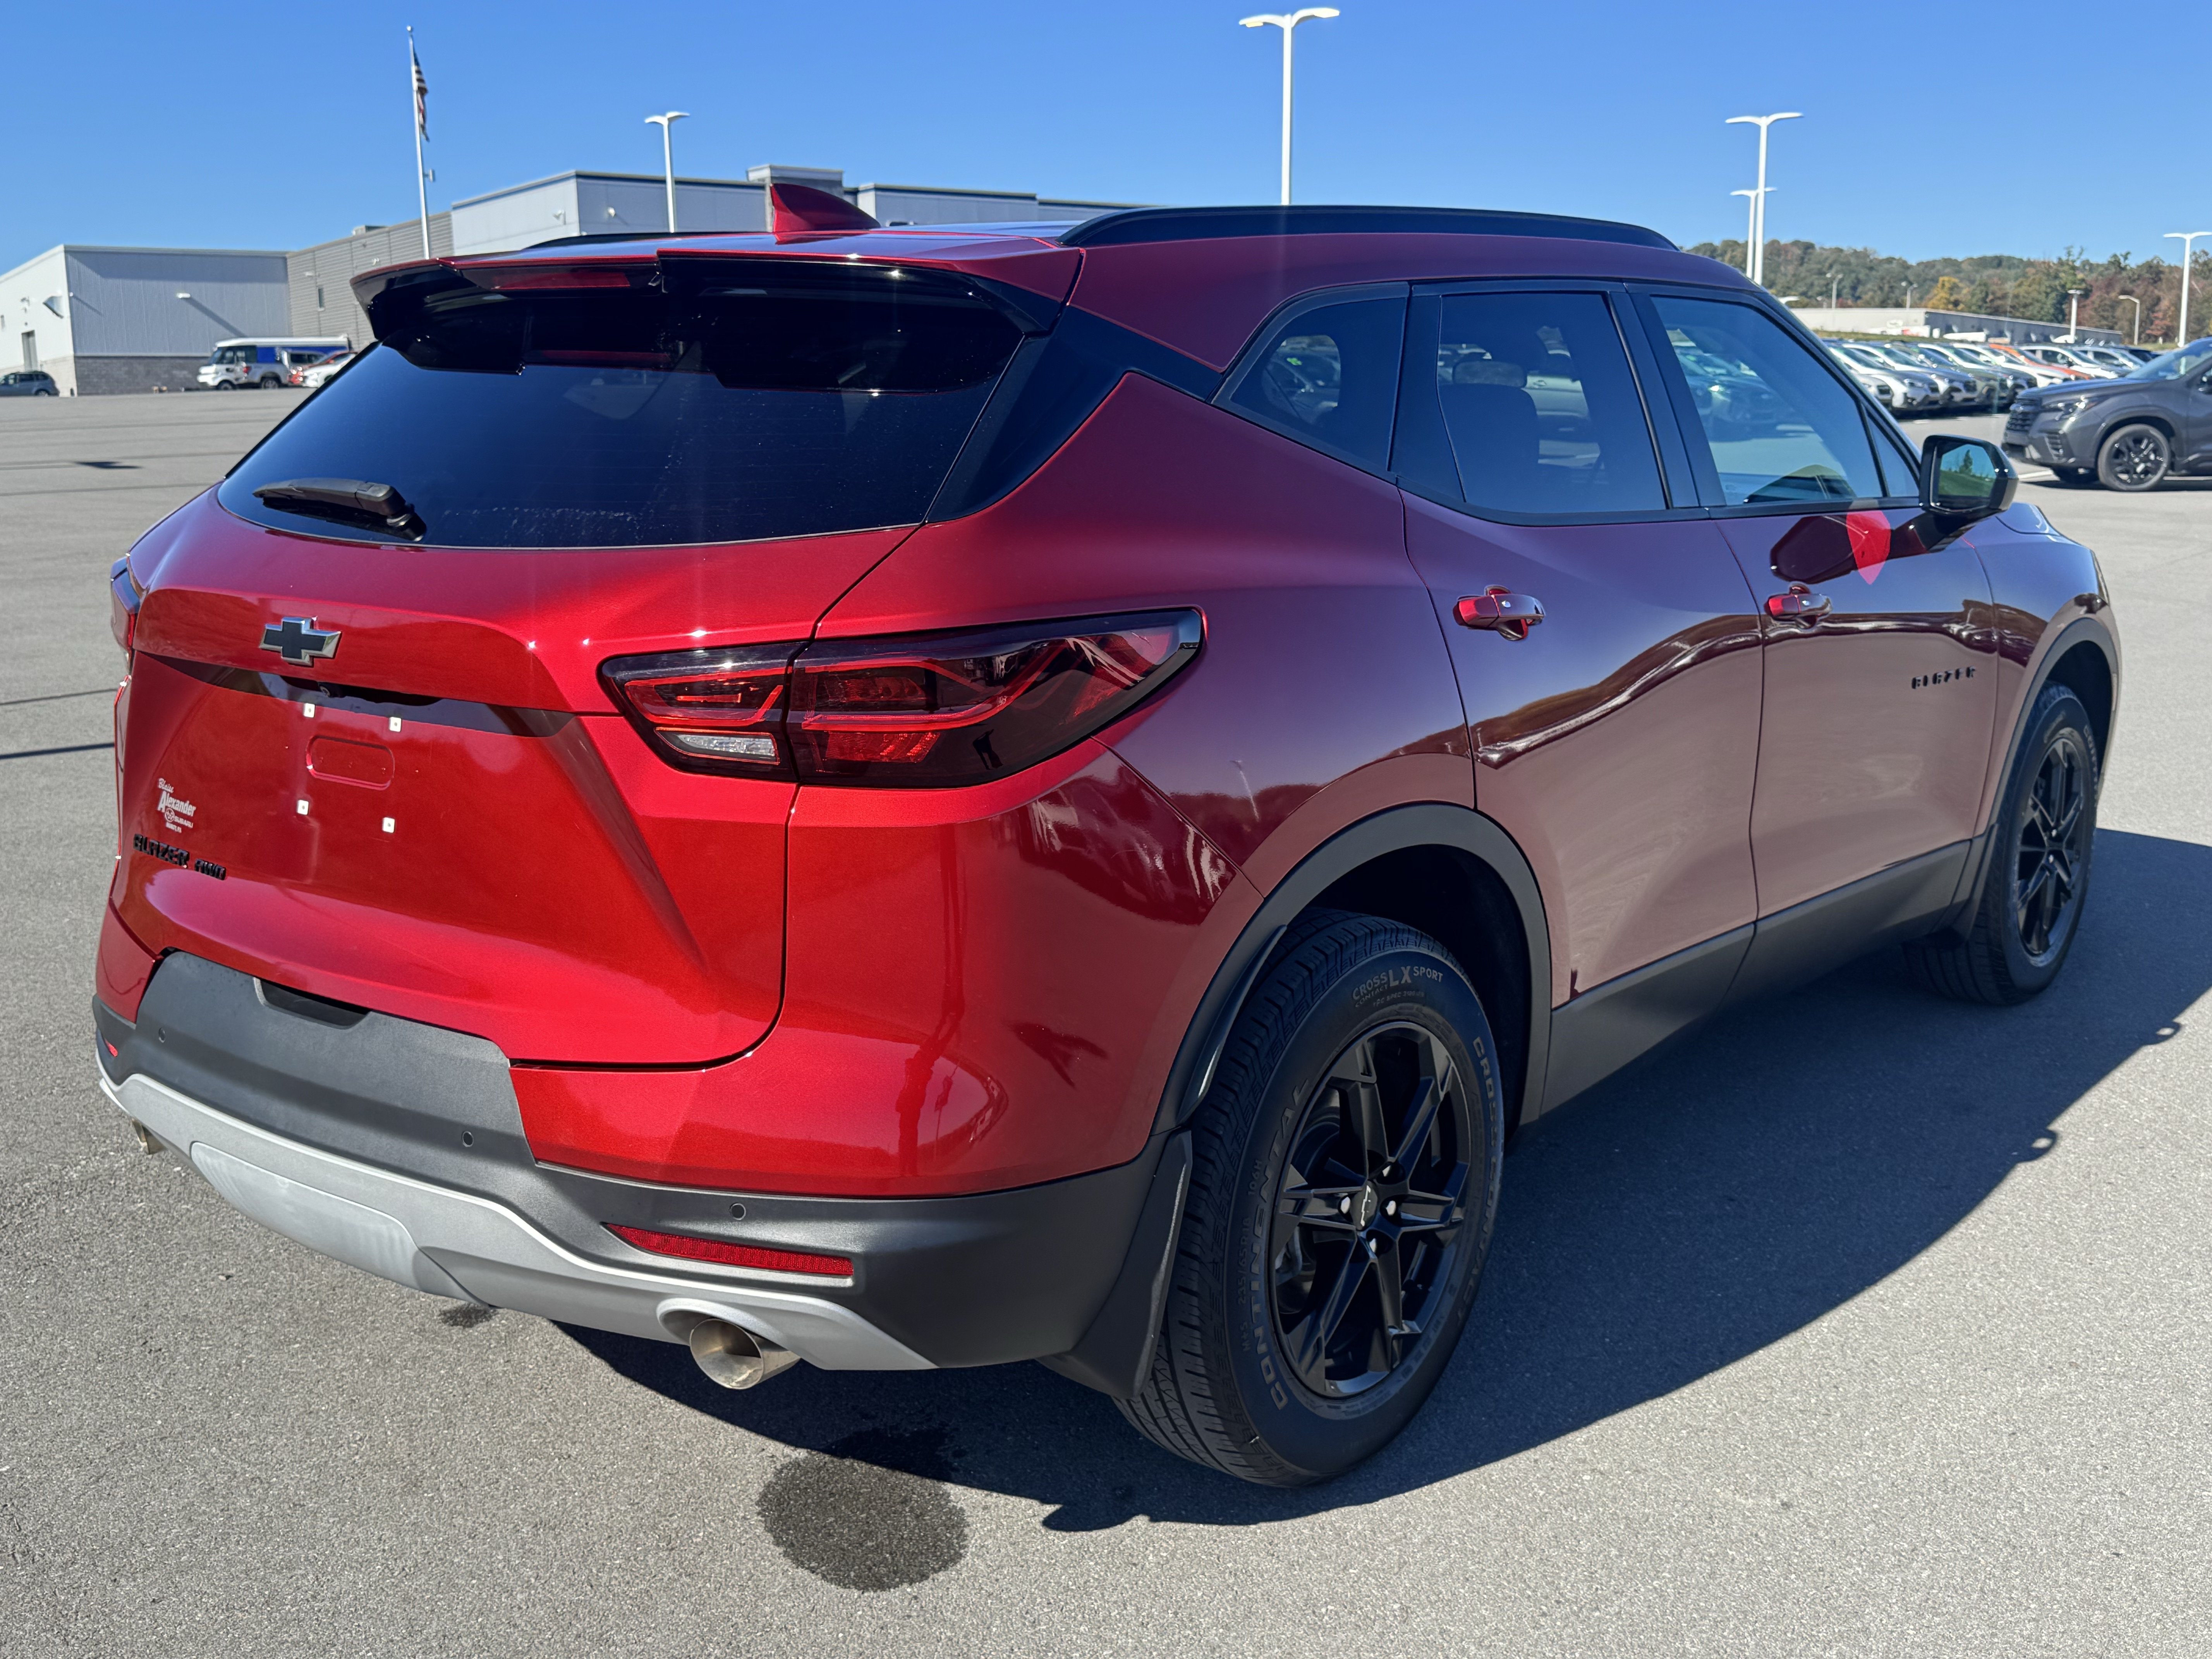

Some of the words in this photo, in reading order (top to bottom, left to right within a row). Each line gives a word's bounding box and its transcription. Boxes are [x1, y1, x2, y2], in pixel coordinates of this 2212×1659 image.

[157, 790, 196, 817] Alexander
[133, 834, 190, 869] BLAZER
[194, 858, 227, 881] AWD
[1352, 972, 1388, 1000] CROSS
[1388, 965, 1412, 987] LX
[1413, 966, 1444, 983] SPORT
[1355, 984, 1388, 1008] CONTACT
[1250, 1078, 1309, 1410] CONTINENTAL
